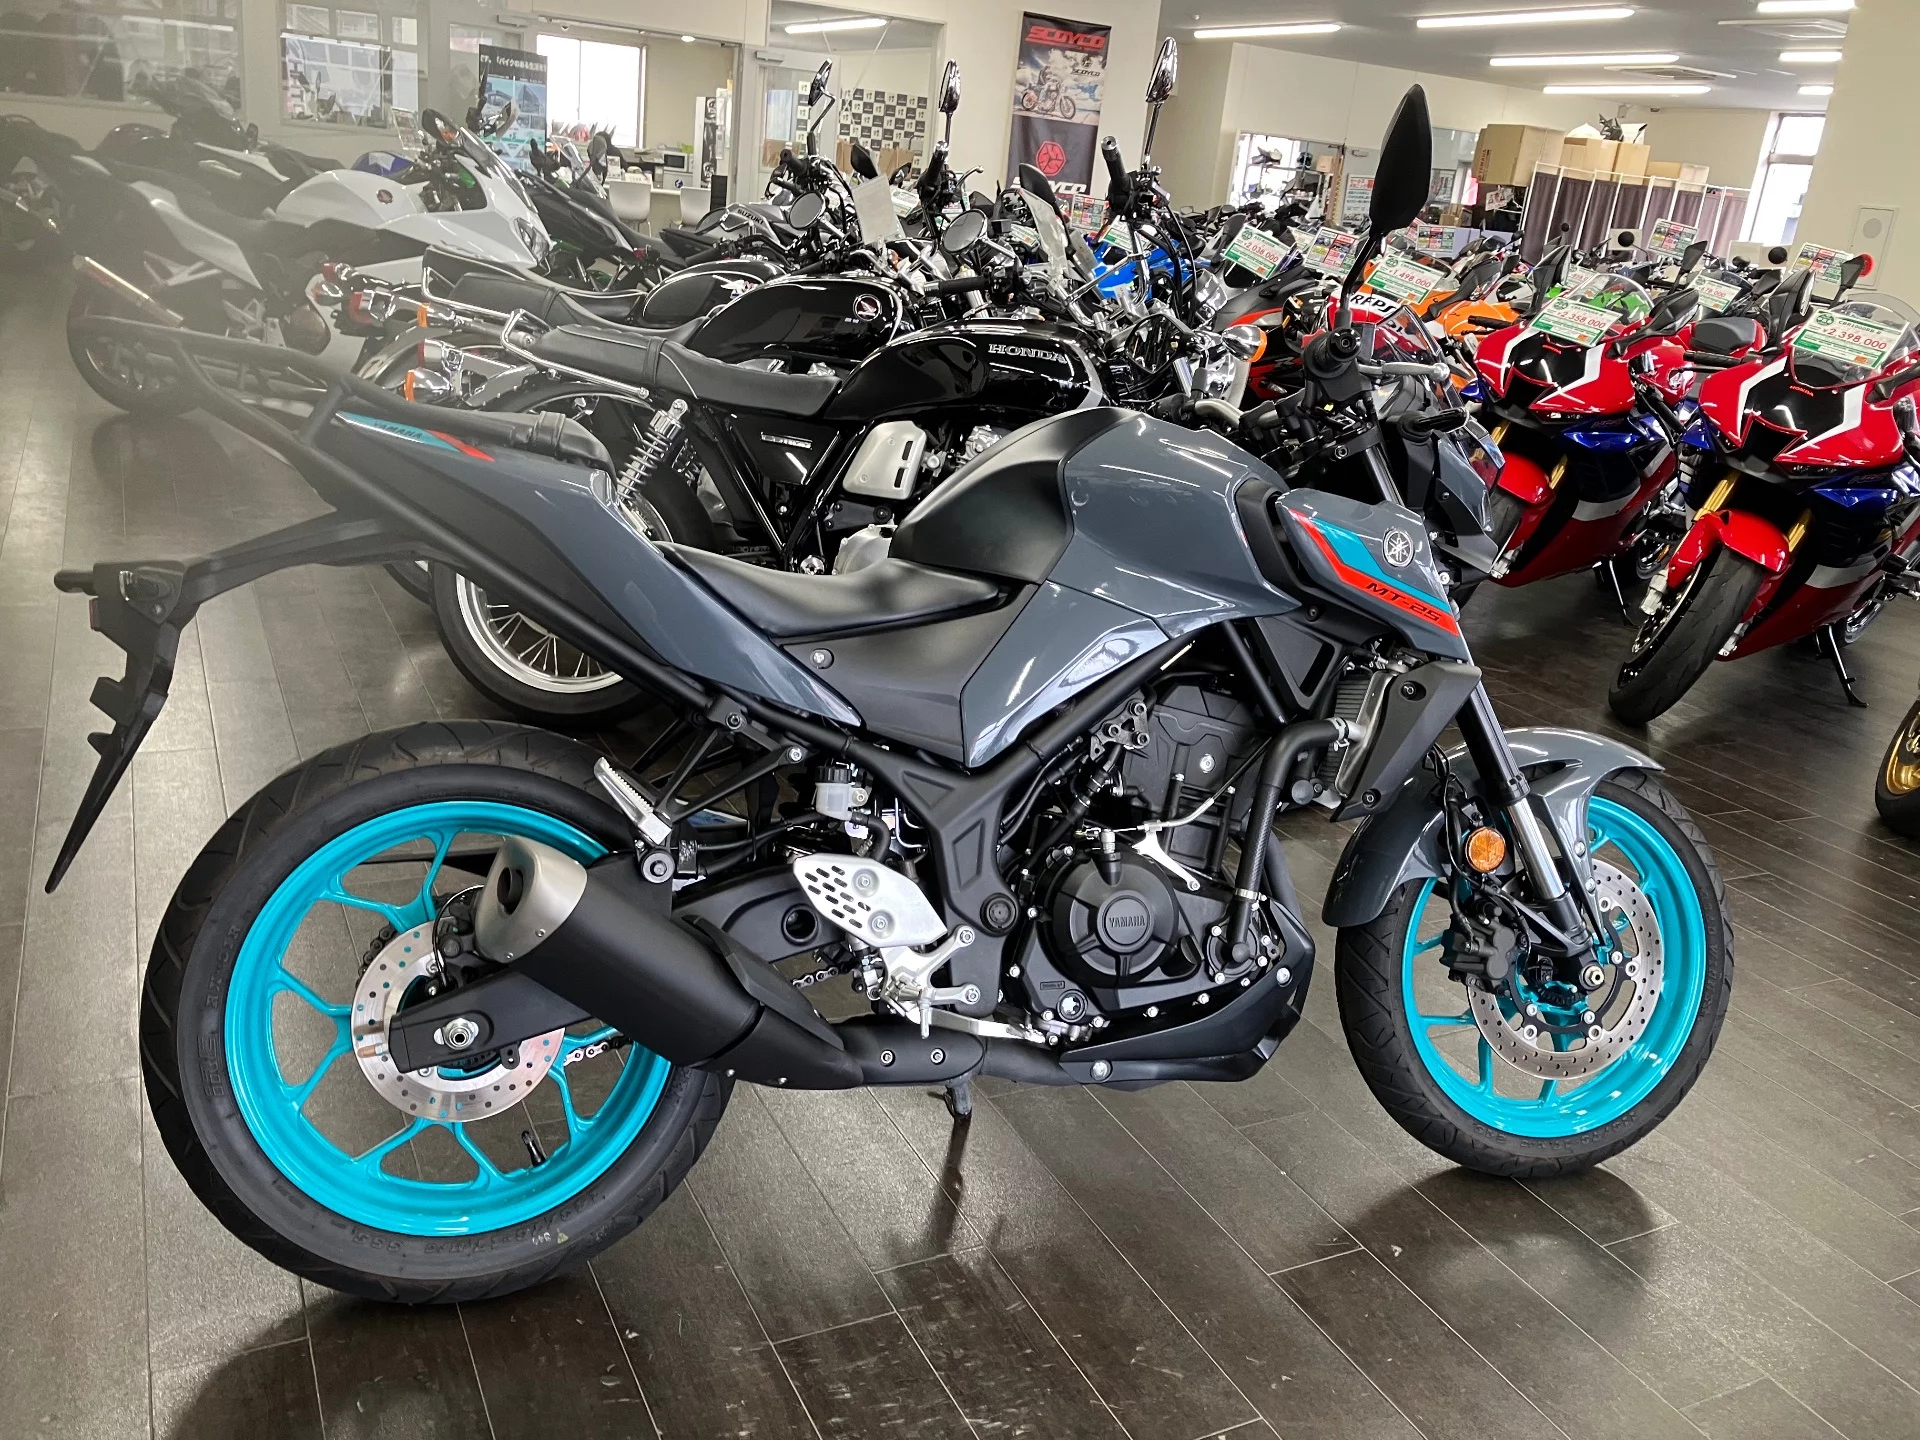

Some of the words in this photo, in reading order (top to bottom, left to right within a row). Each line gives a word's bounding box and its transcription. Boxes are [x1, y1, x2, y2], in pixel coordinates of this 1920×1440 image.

[1025, 25, 1106, 49] SCOYCO
[737, 209, 764, 225] SUZUKI
[988, 343, 1068, 364] HONDA
[1789, 385, 1815, 397] HONDA
[374, 421, 423, 438] YAMAHA
[1366, 582, 1442, 622] MT-25
[1109, 915, 1146, 928] YAMAHA
